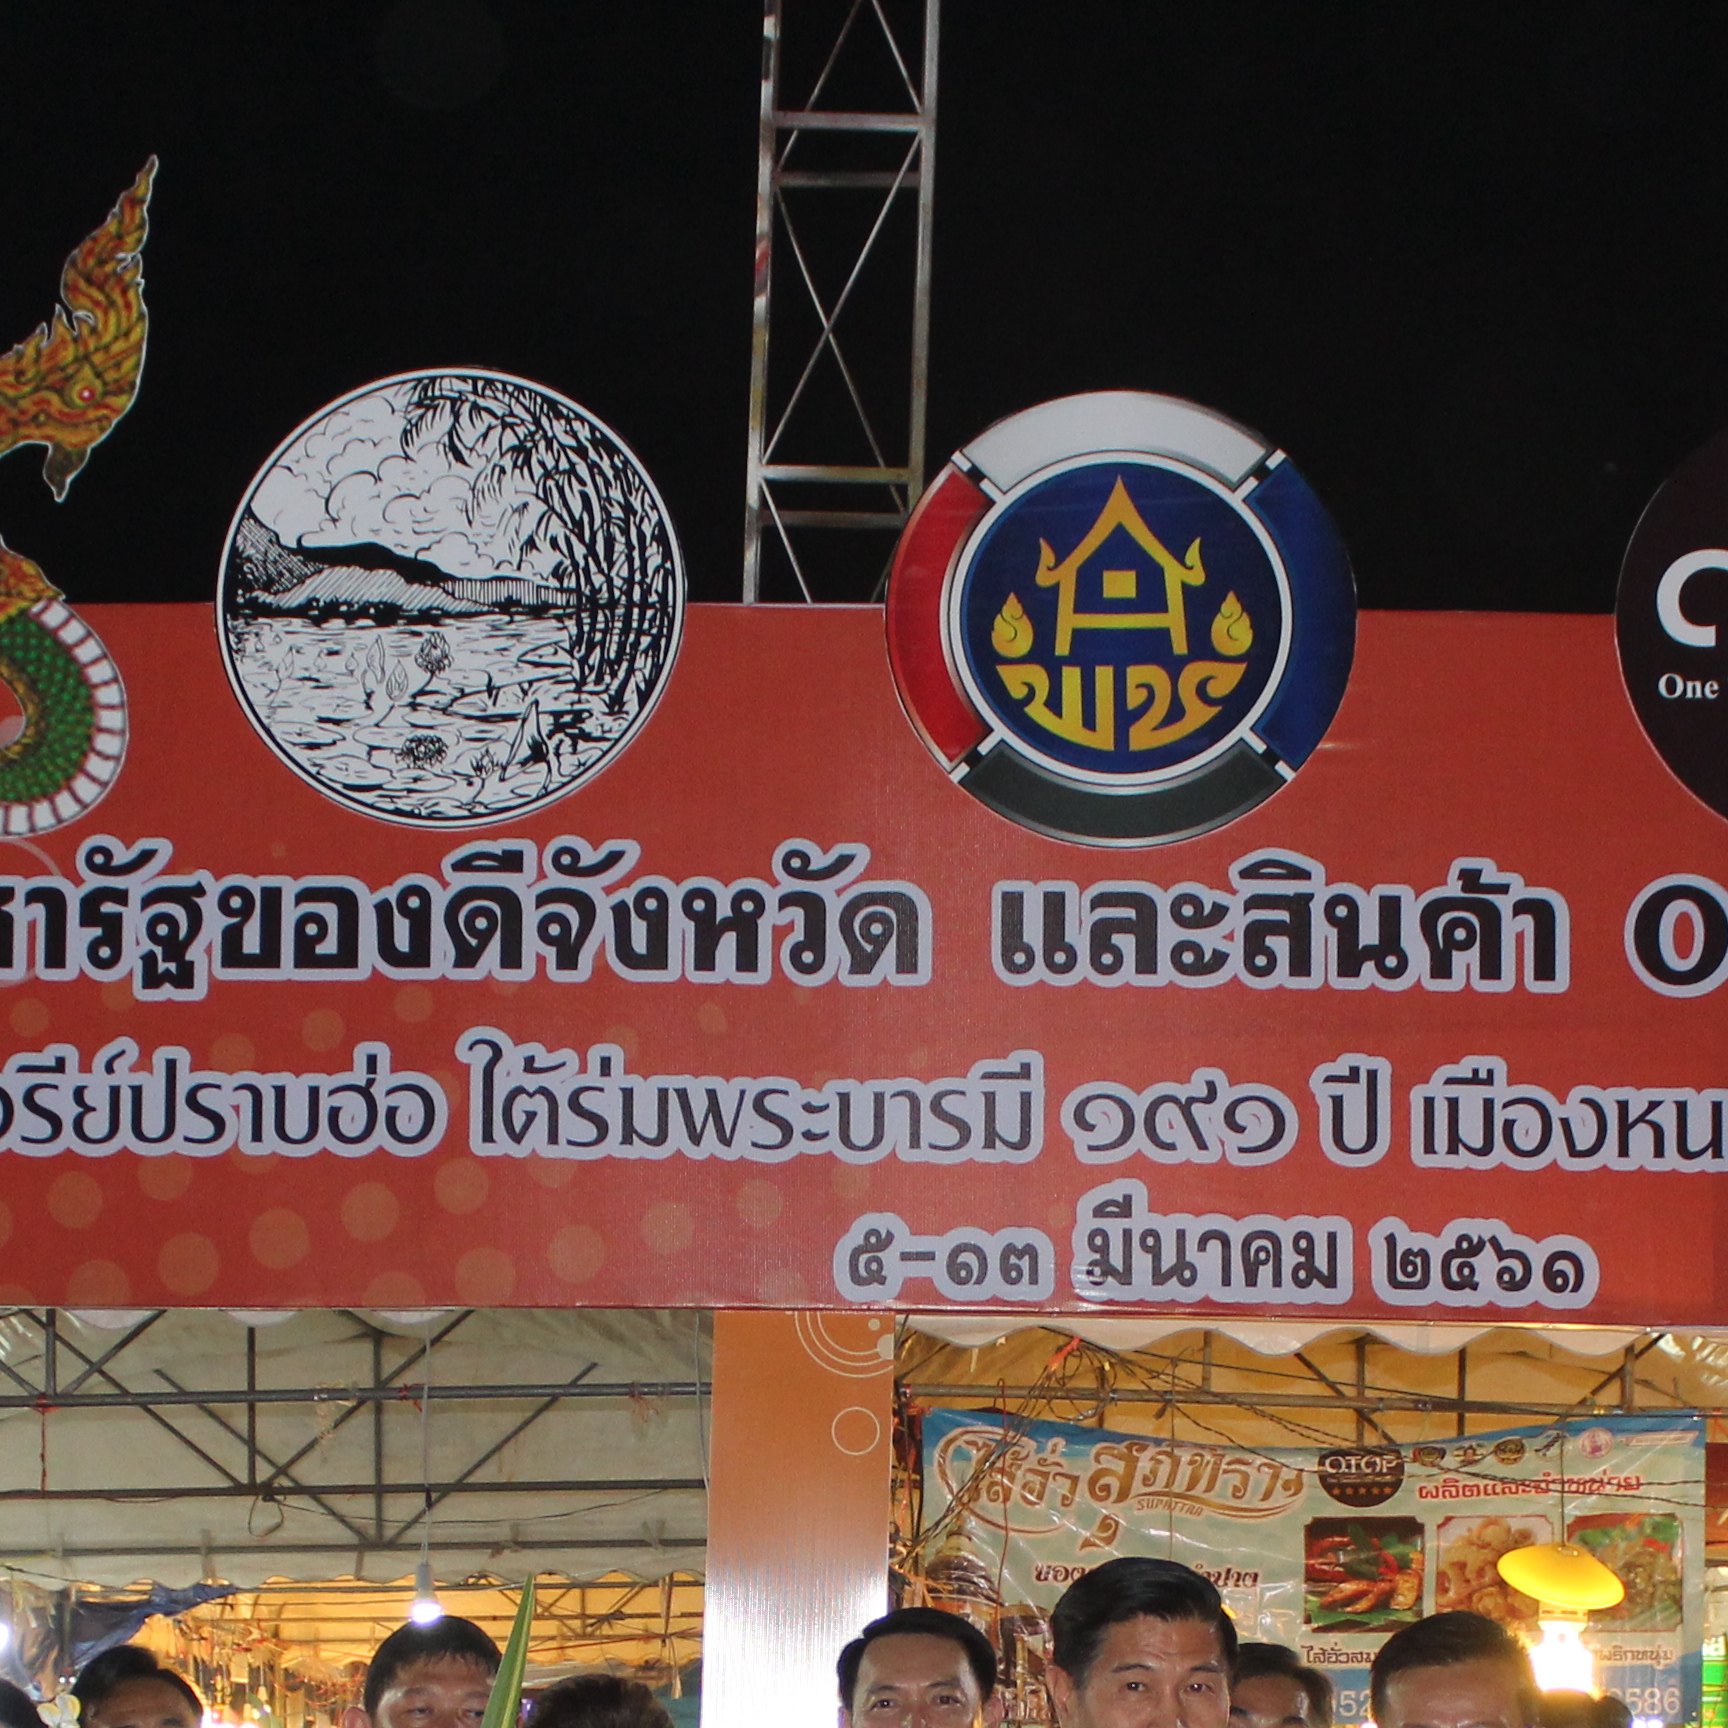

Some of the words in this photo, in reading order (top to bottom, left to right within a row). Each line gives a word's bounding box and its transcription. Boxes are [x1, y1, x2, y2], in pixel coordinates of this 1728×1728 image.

[1658, 672, 1720, 700] One
[998, 860, 1559, 983] และสินค้า
[468, 1038, 1034, 1153] ใต้ร่มพระบารมี
[1073, 1074, 1288, 1158] ๑๙๑
[1324, 1065, 1380, 1154] ปี
[847, 1226, 1042, 1290] ๕-๑๓
[1085, 1201, 1343, 1293] มีนาคม
[1383, 1234, 1587, 1296] ๒๕๖๑
[1325, 1454, 1401, 1474] OTOP
